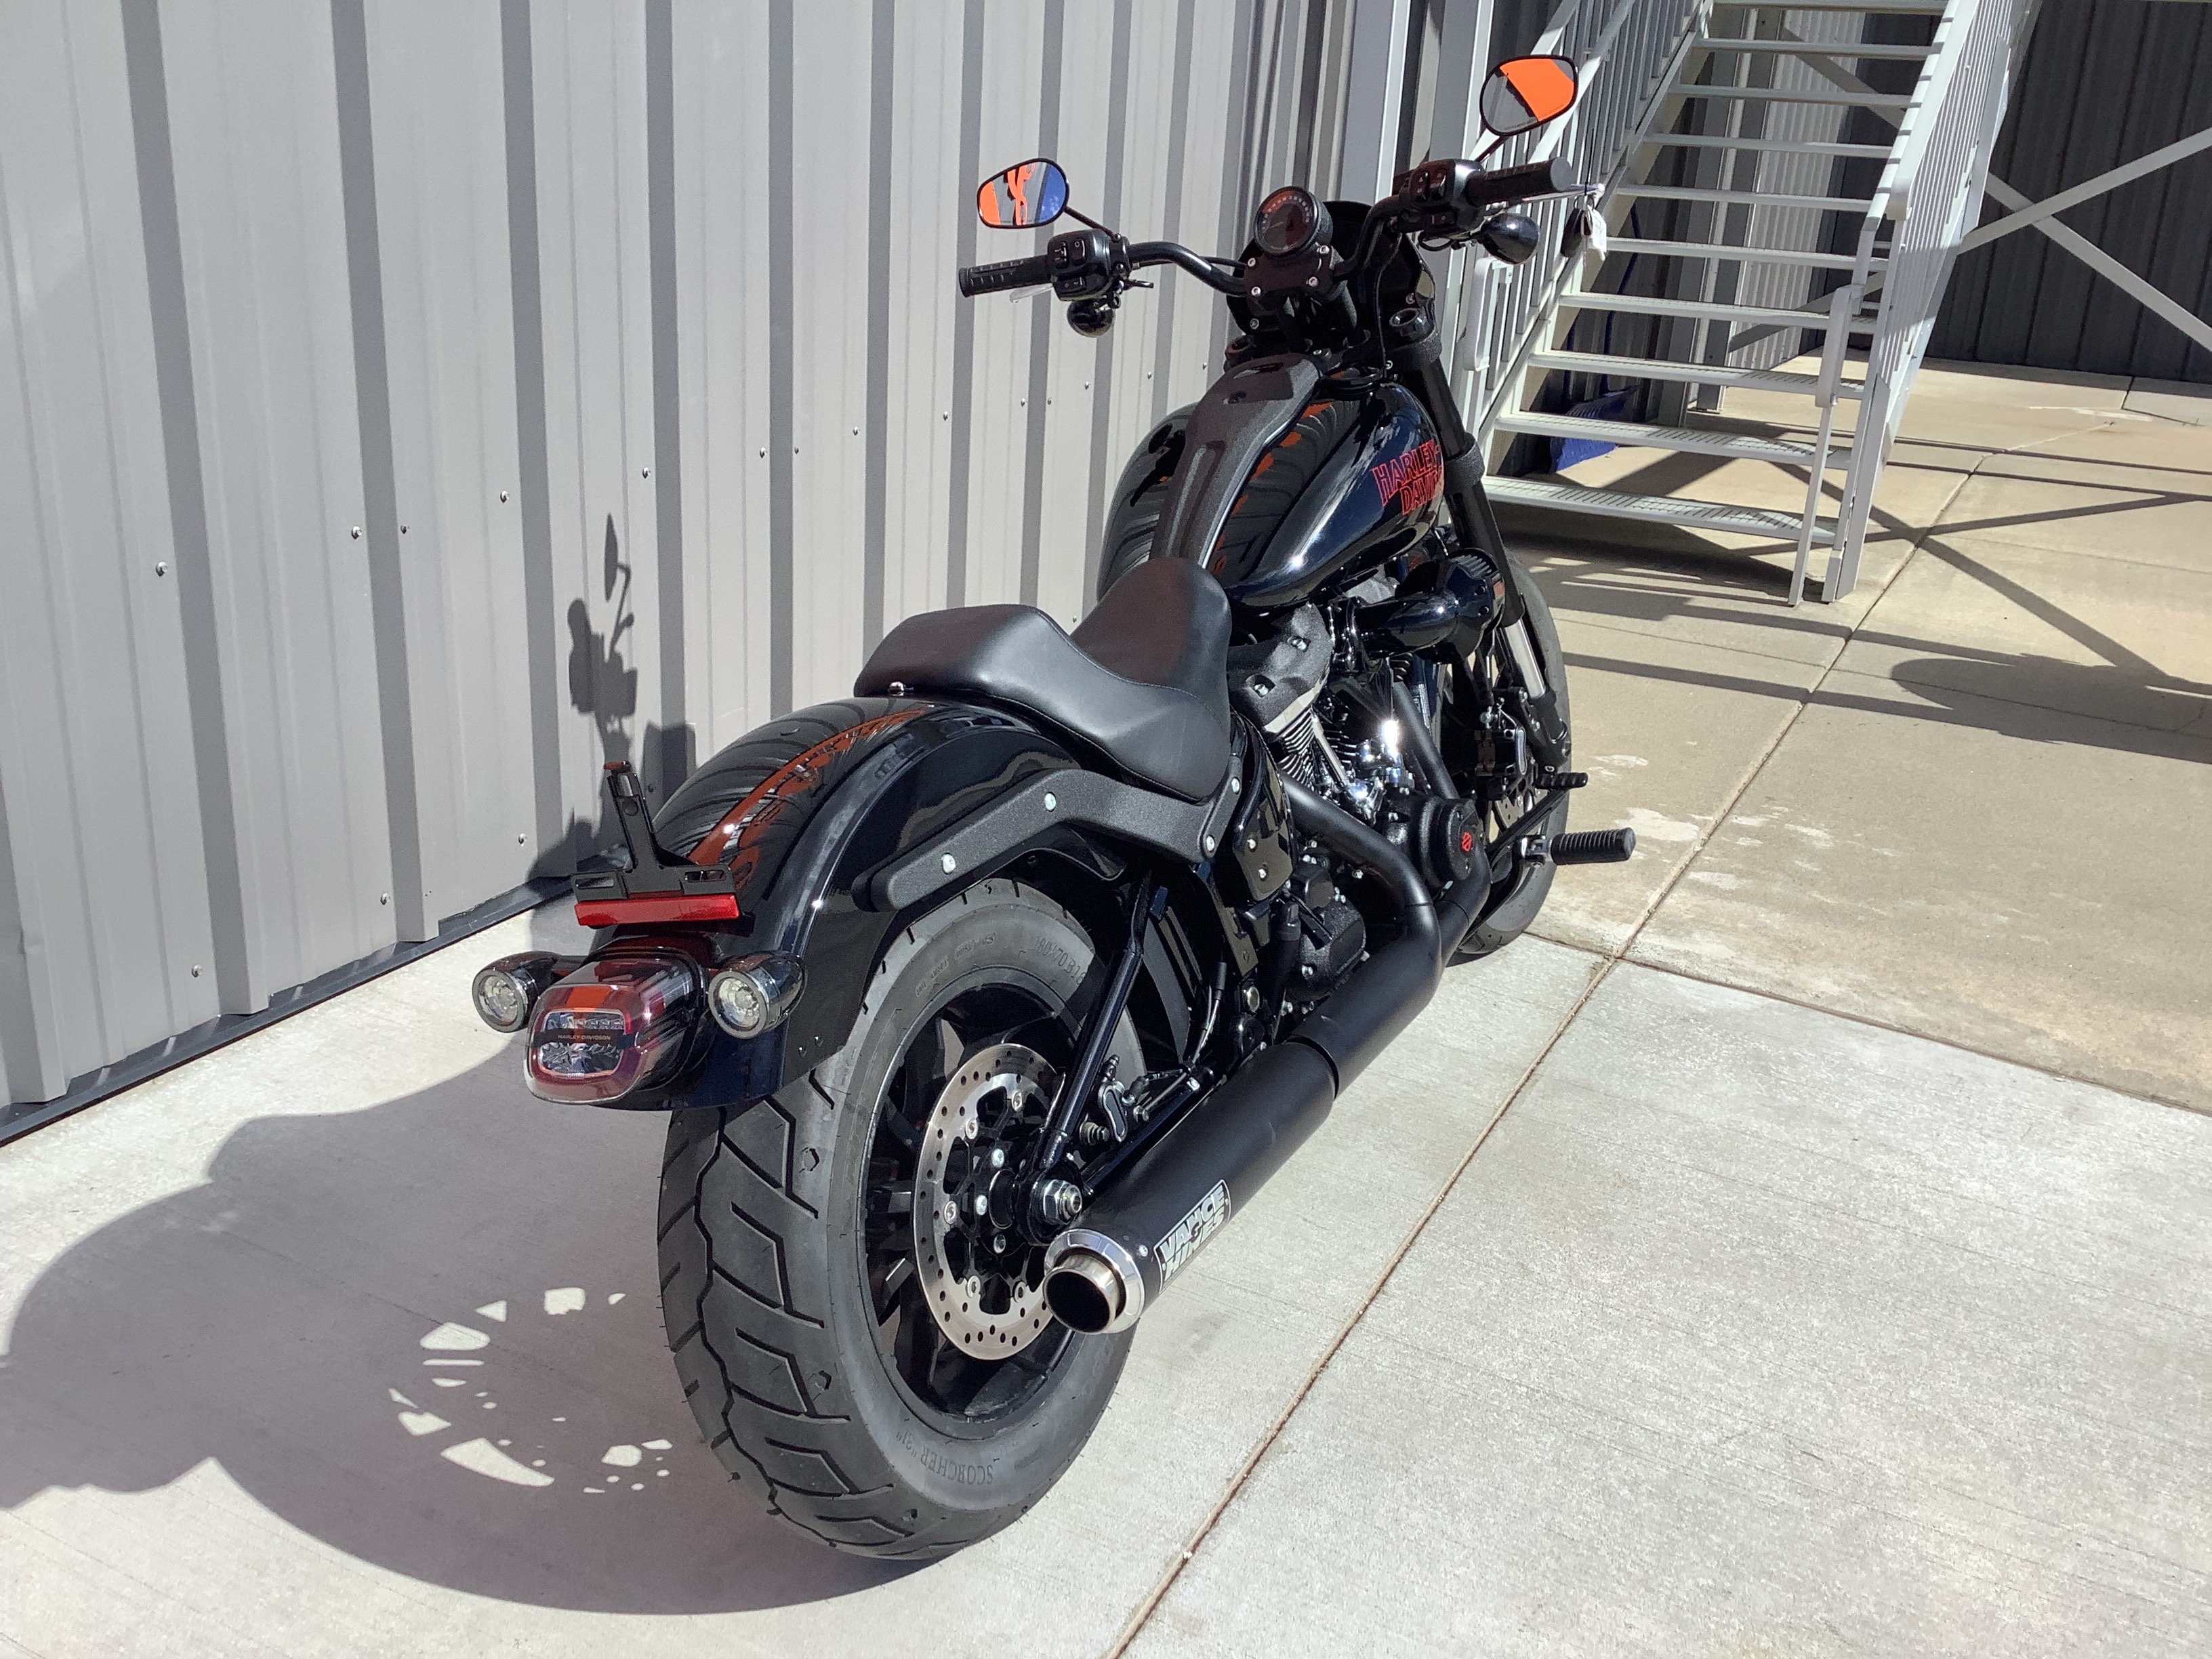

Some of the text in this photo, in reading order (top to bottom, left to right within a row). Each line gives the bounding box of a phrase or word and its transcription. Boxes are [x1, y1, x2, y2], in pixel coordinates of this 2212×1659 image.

[1159, 1185, 1225, 1263] VANCE
[1164, 1206, 1225, 1282] HINES
[920, 1445, 994, 1485] SCORCHER
